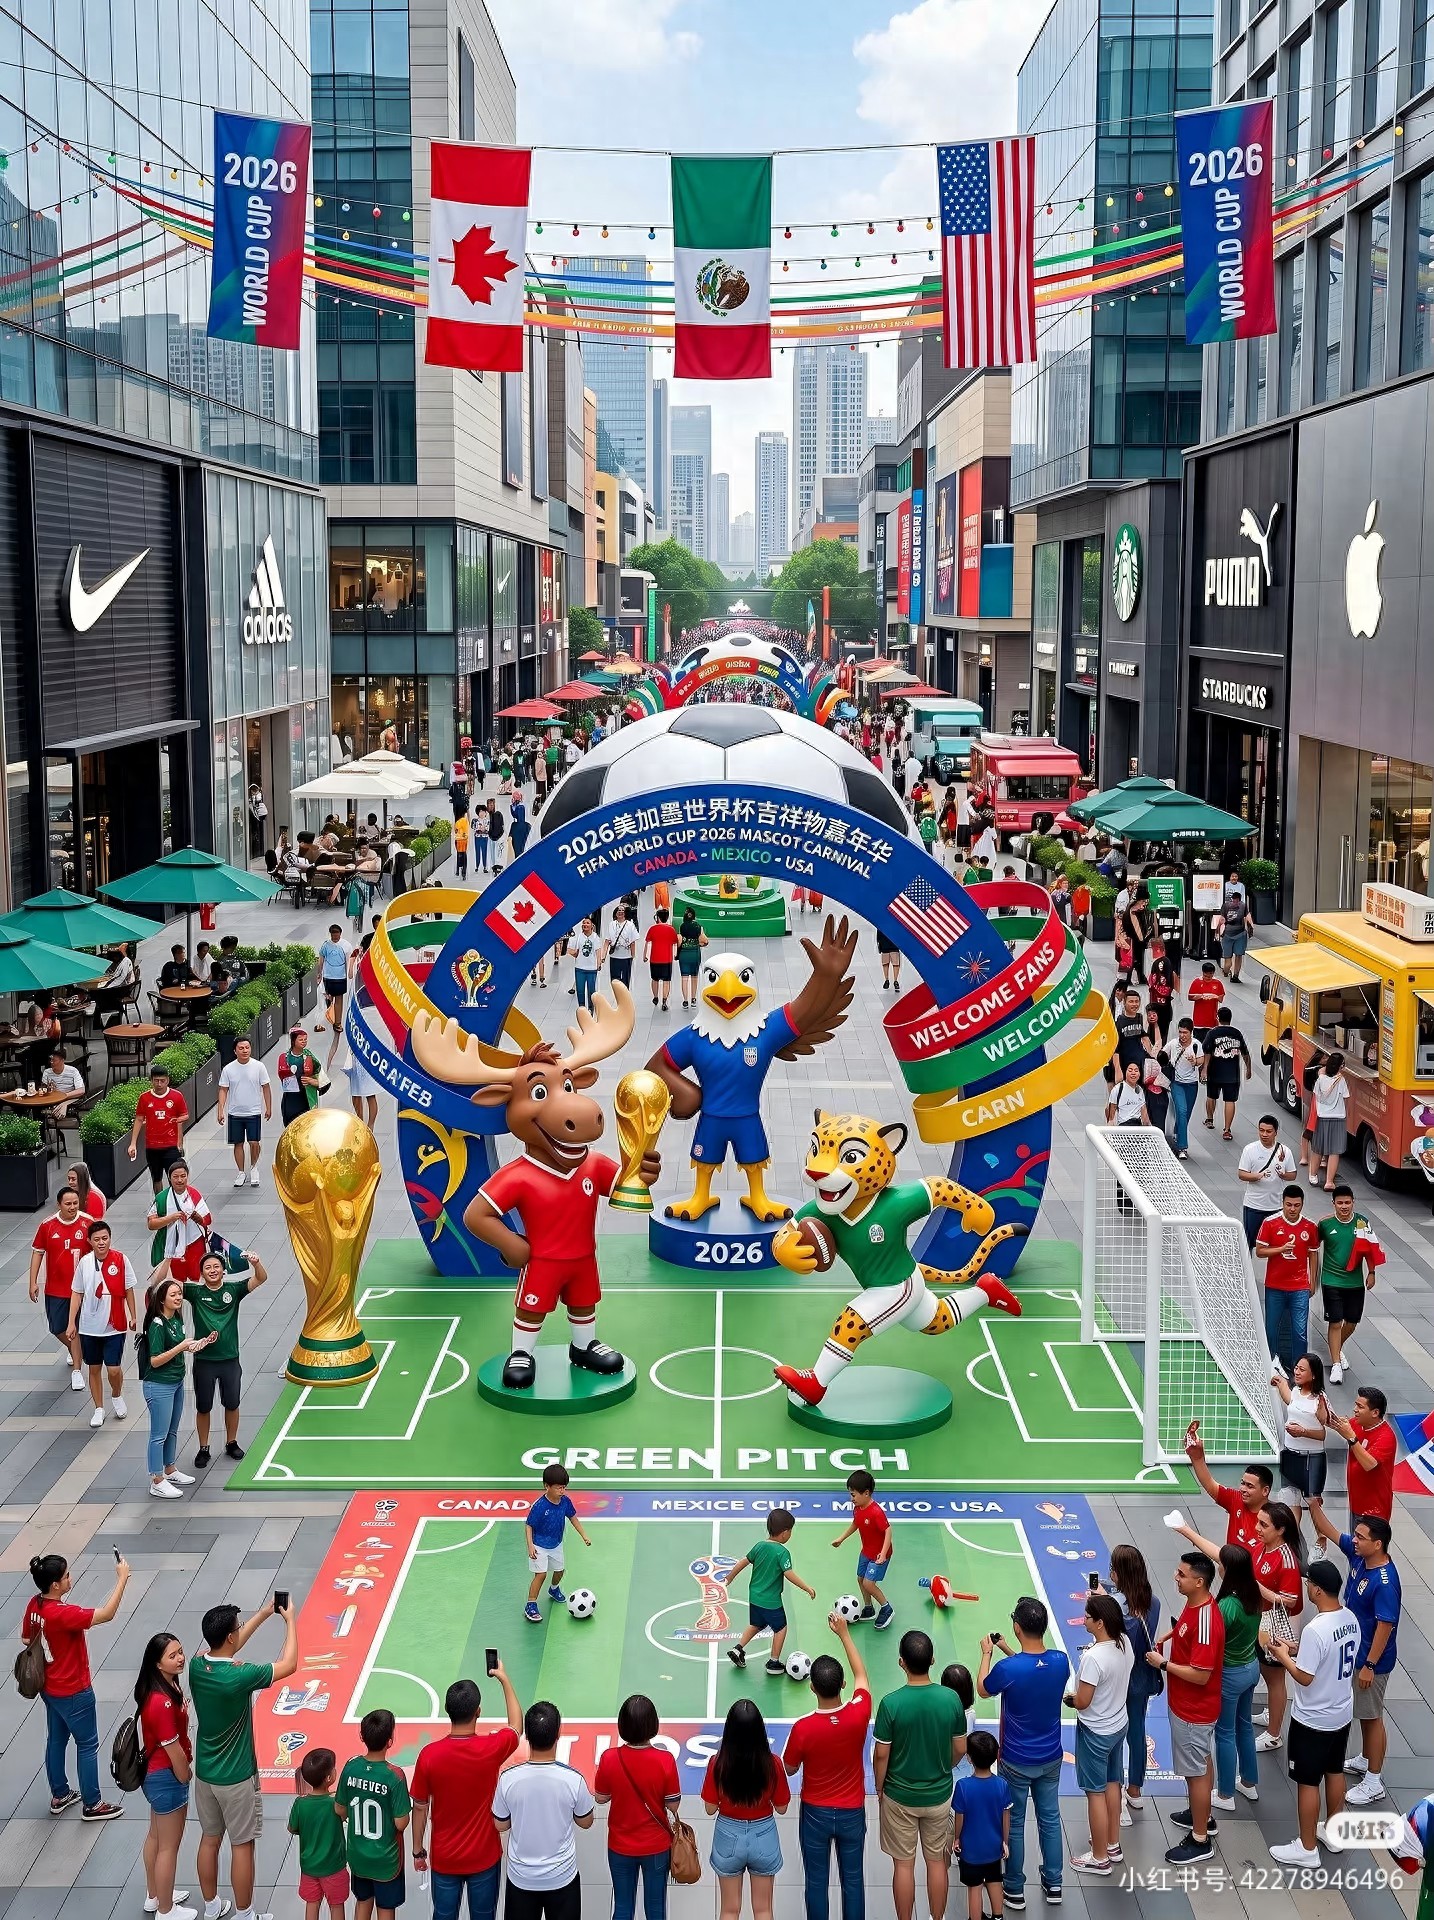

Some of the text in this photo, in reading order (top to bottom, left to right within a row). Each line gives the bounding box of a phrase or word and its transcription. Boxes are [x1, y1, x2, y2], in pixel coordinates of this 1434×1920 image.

[223, 152, 298, 194] 2026
[1188, 142, 1263, 187] 2026
[242, 195, 272, 326] WORLD CUP
[1214, 187, 1246, 322] WORLD CUP
[1204, 556, 1260, 607] PUMA
[243, 608, 293, 645] adidas
[1202, 677, 1267, 710] STARBUCKS
[557, 797, 894, 866] 2026美加墨世界杯吉祥物嘉年华
[576, 827, 872, 881] FIFA WORLD CUP 2026 MASCOT CARNIVAL
[632, 847, 814, 877] CANADA MEXICO USA
[909, 941, 1056, 1050] WELCOME FANS
[694, 1241, 764, 1264] 2026
[520, 1446, 911, 1471] GREEN PITCH
[437, 1499, 531, 1511] CANAD
[651, 1499, 1004, 1513] MEXICE CUP MXICO USA
[349, 1796, 383, 1840] 10
